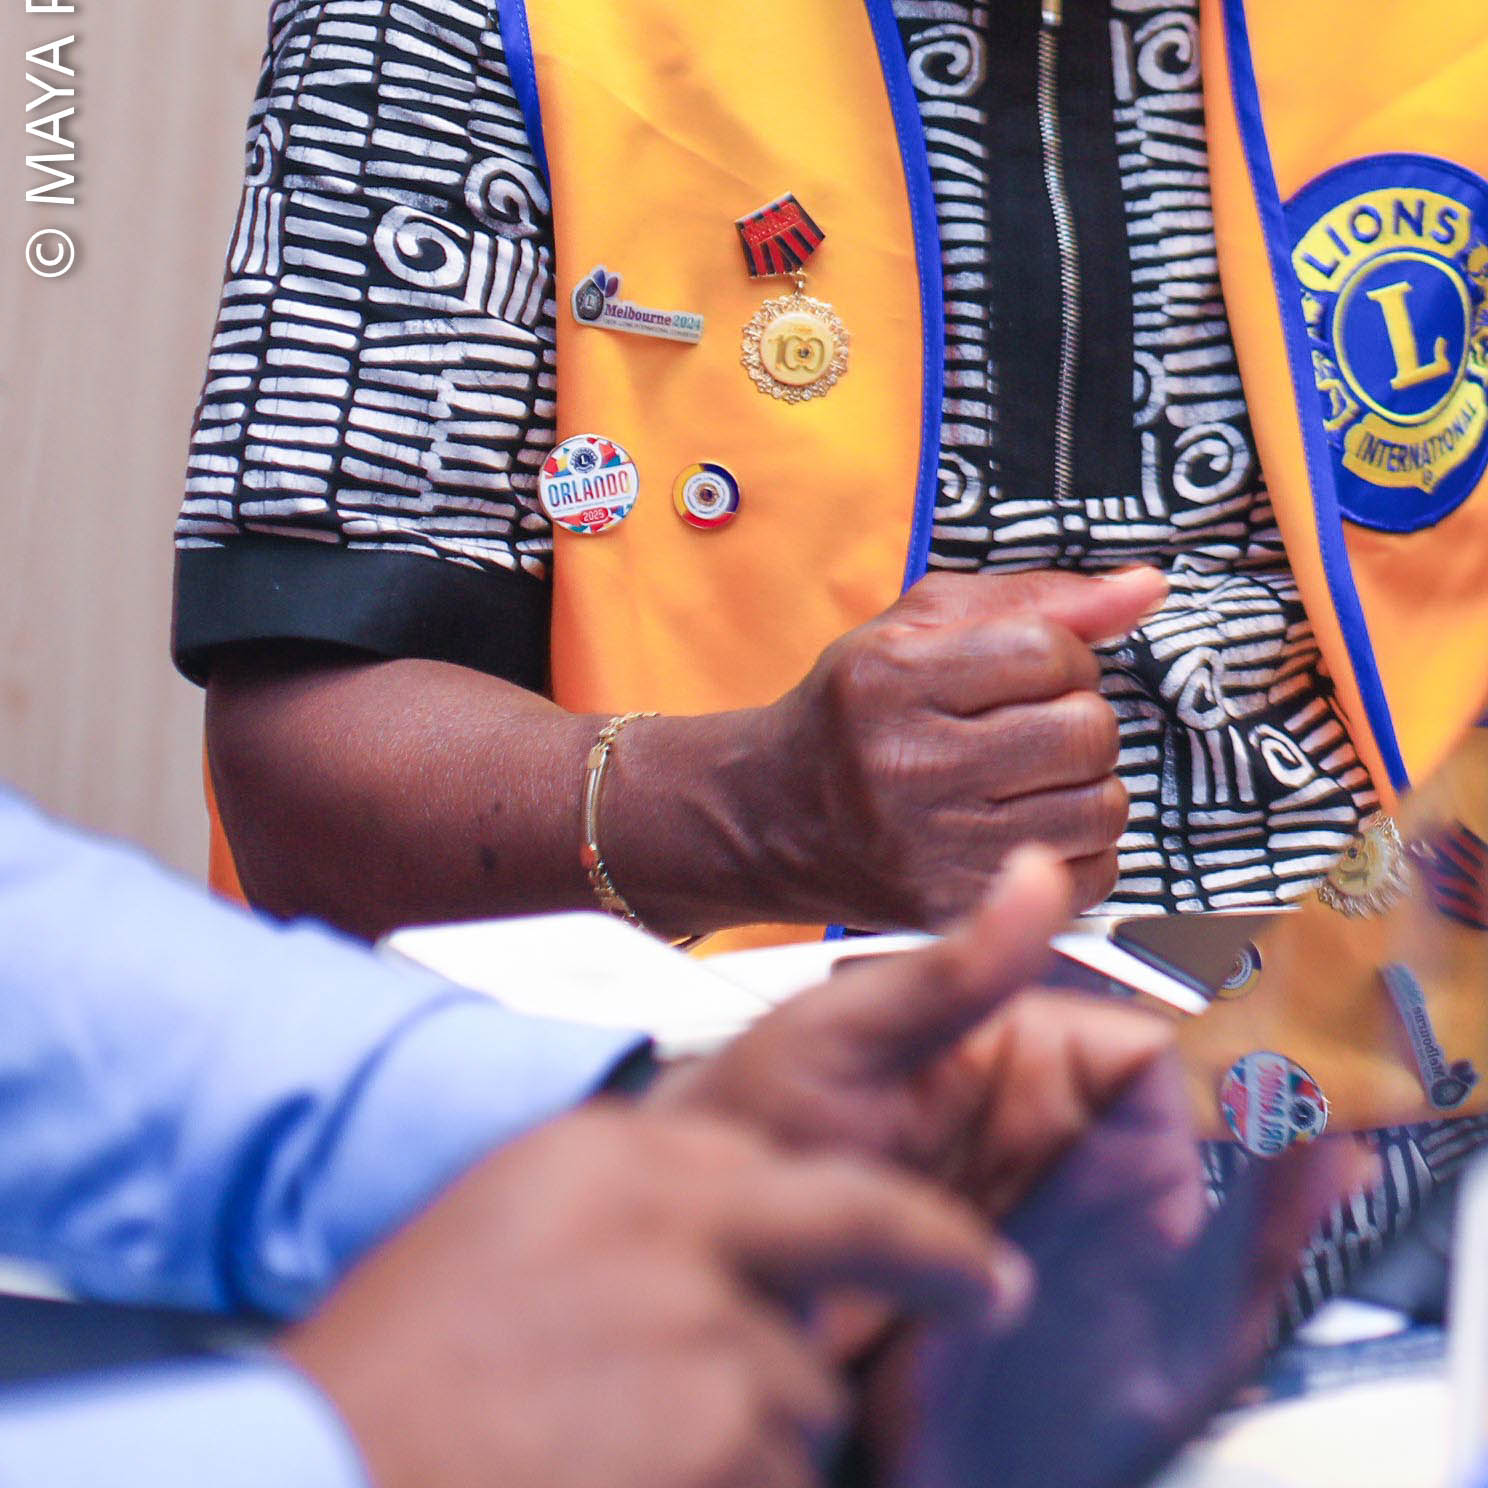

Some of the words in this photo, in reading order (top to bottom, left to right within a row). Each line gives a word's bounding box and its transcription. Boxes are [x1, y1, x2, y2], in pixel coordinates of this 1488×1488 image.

[1302, 199, 1460, 279] LIONS
[604, 303, 672, 327] Melbourne
[672, 314, 701, 332] 2024
[1366, 281, 1451, 390] L
[1356, 400, 1478, 472] INTERNATIONAL
[548, 470, 631, 508] ORLANDO
